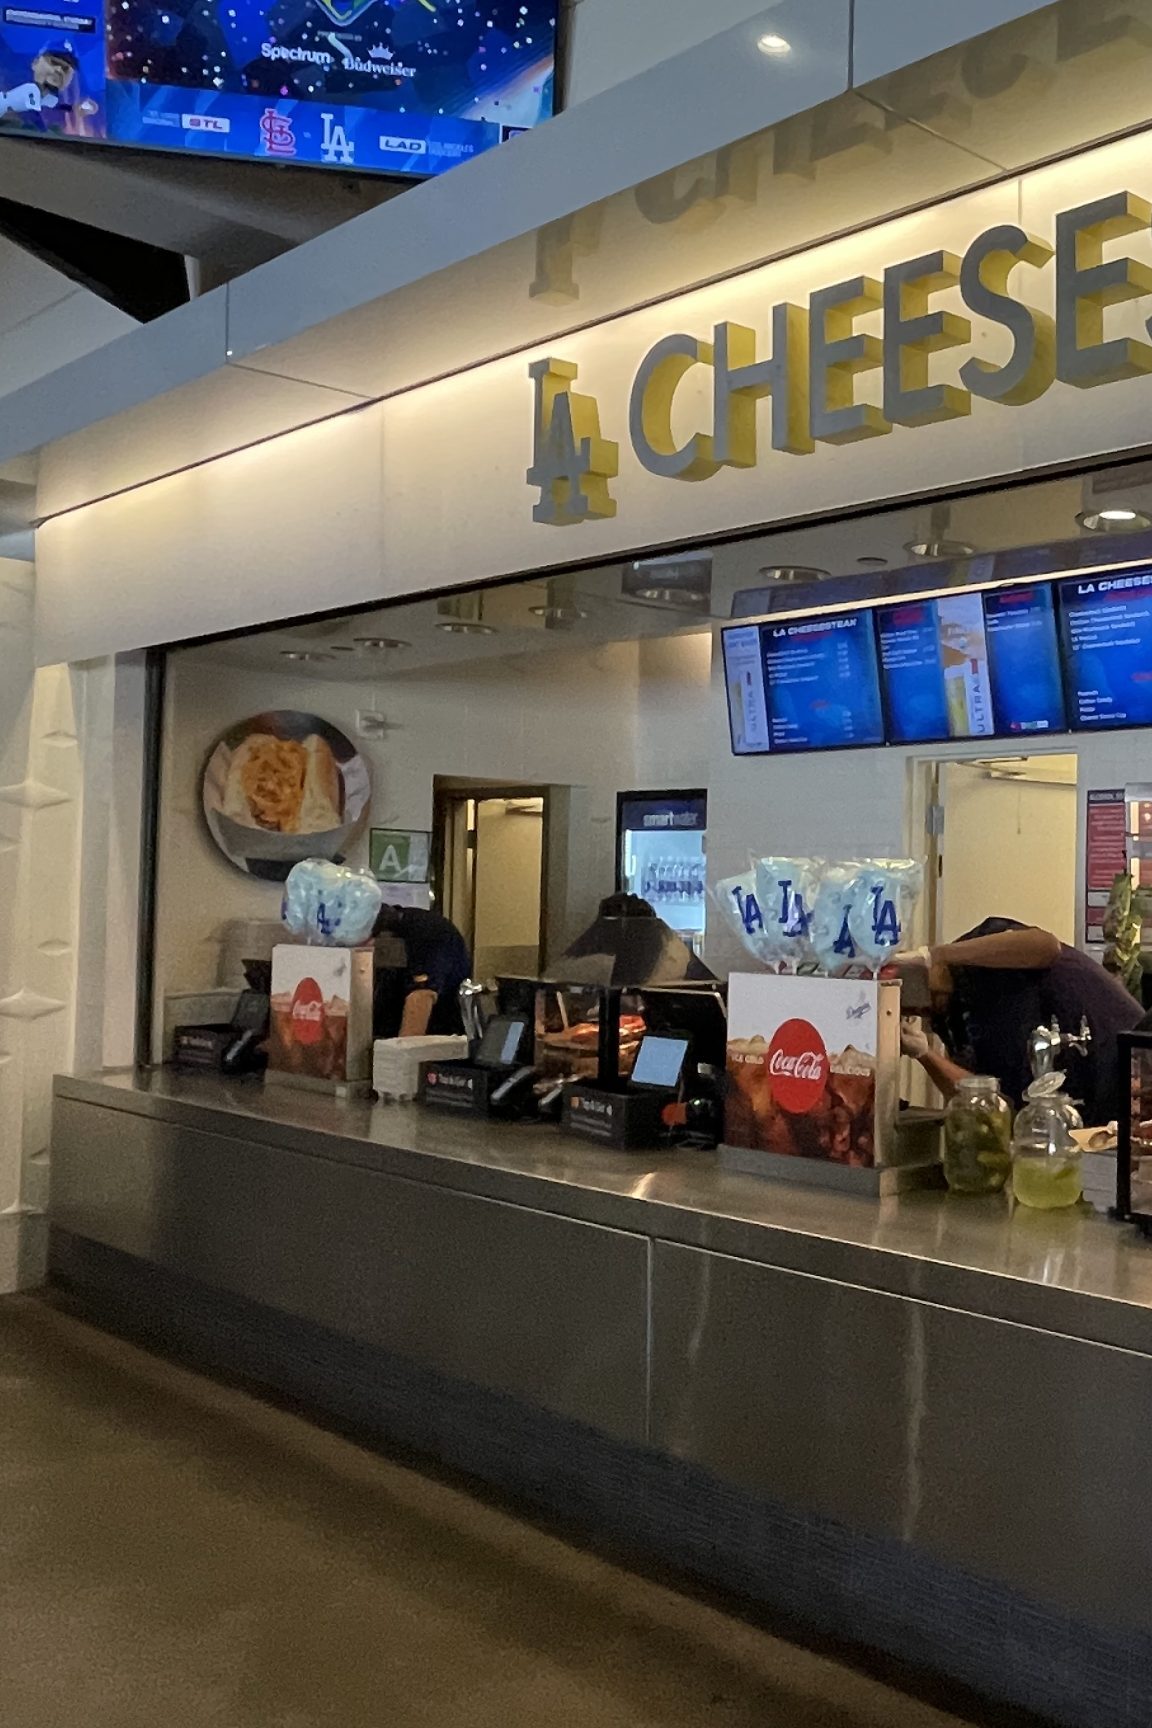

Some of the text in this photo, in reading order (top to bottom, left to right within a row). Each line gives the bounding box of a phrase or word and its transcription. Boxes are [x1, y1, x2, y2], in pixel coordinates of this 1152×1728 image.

[261, 42, 331, 64] Spectrum
[321, 112, 354, 164] LA
[384, 139, 422, 151] LAD
[1078, 584, 1095, 595] LA
[773, 628, 786, 637] LA
[973, 684, 986, 733] ULTRA
[379, 844, 402, 871] A
[770, 1049, 825, 1080] Coca-Cola
